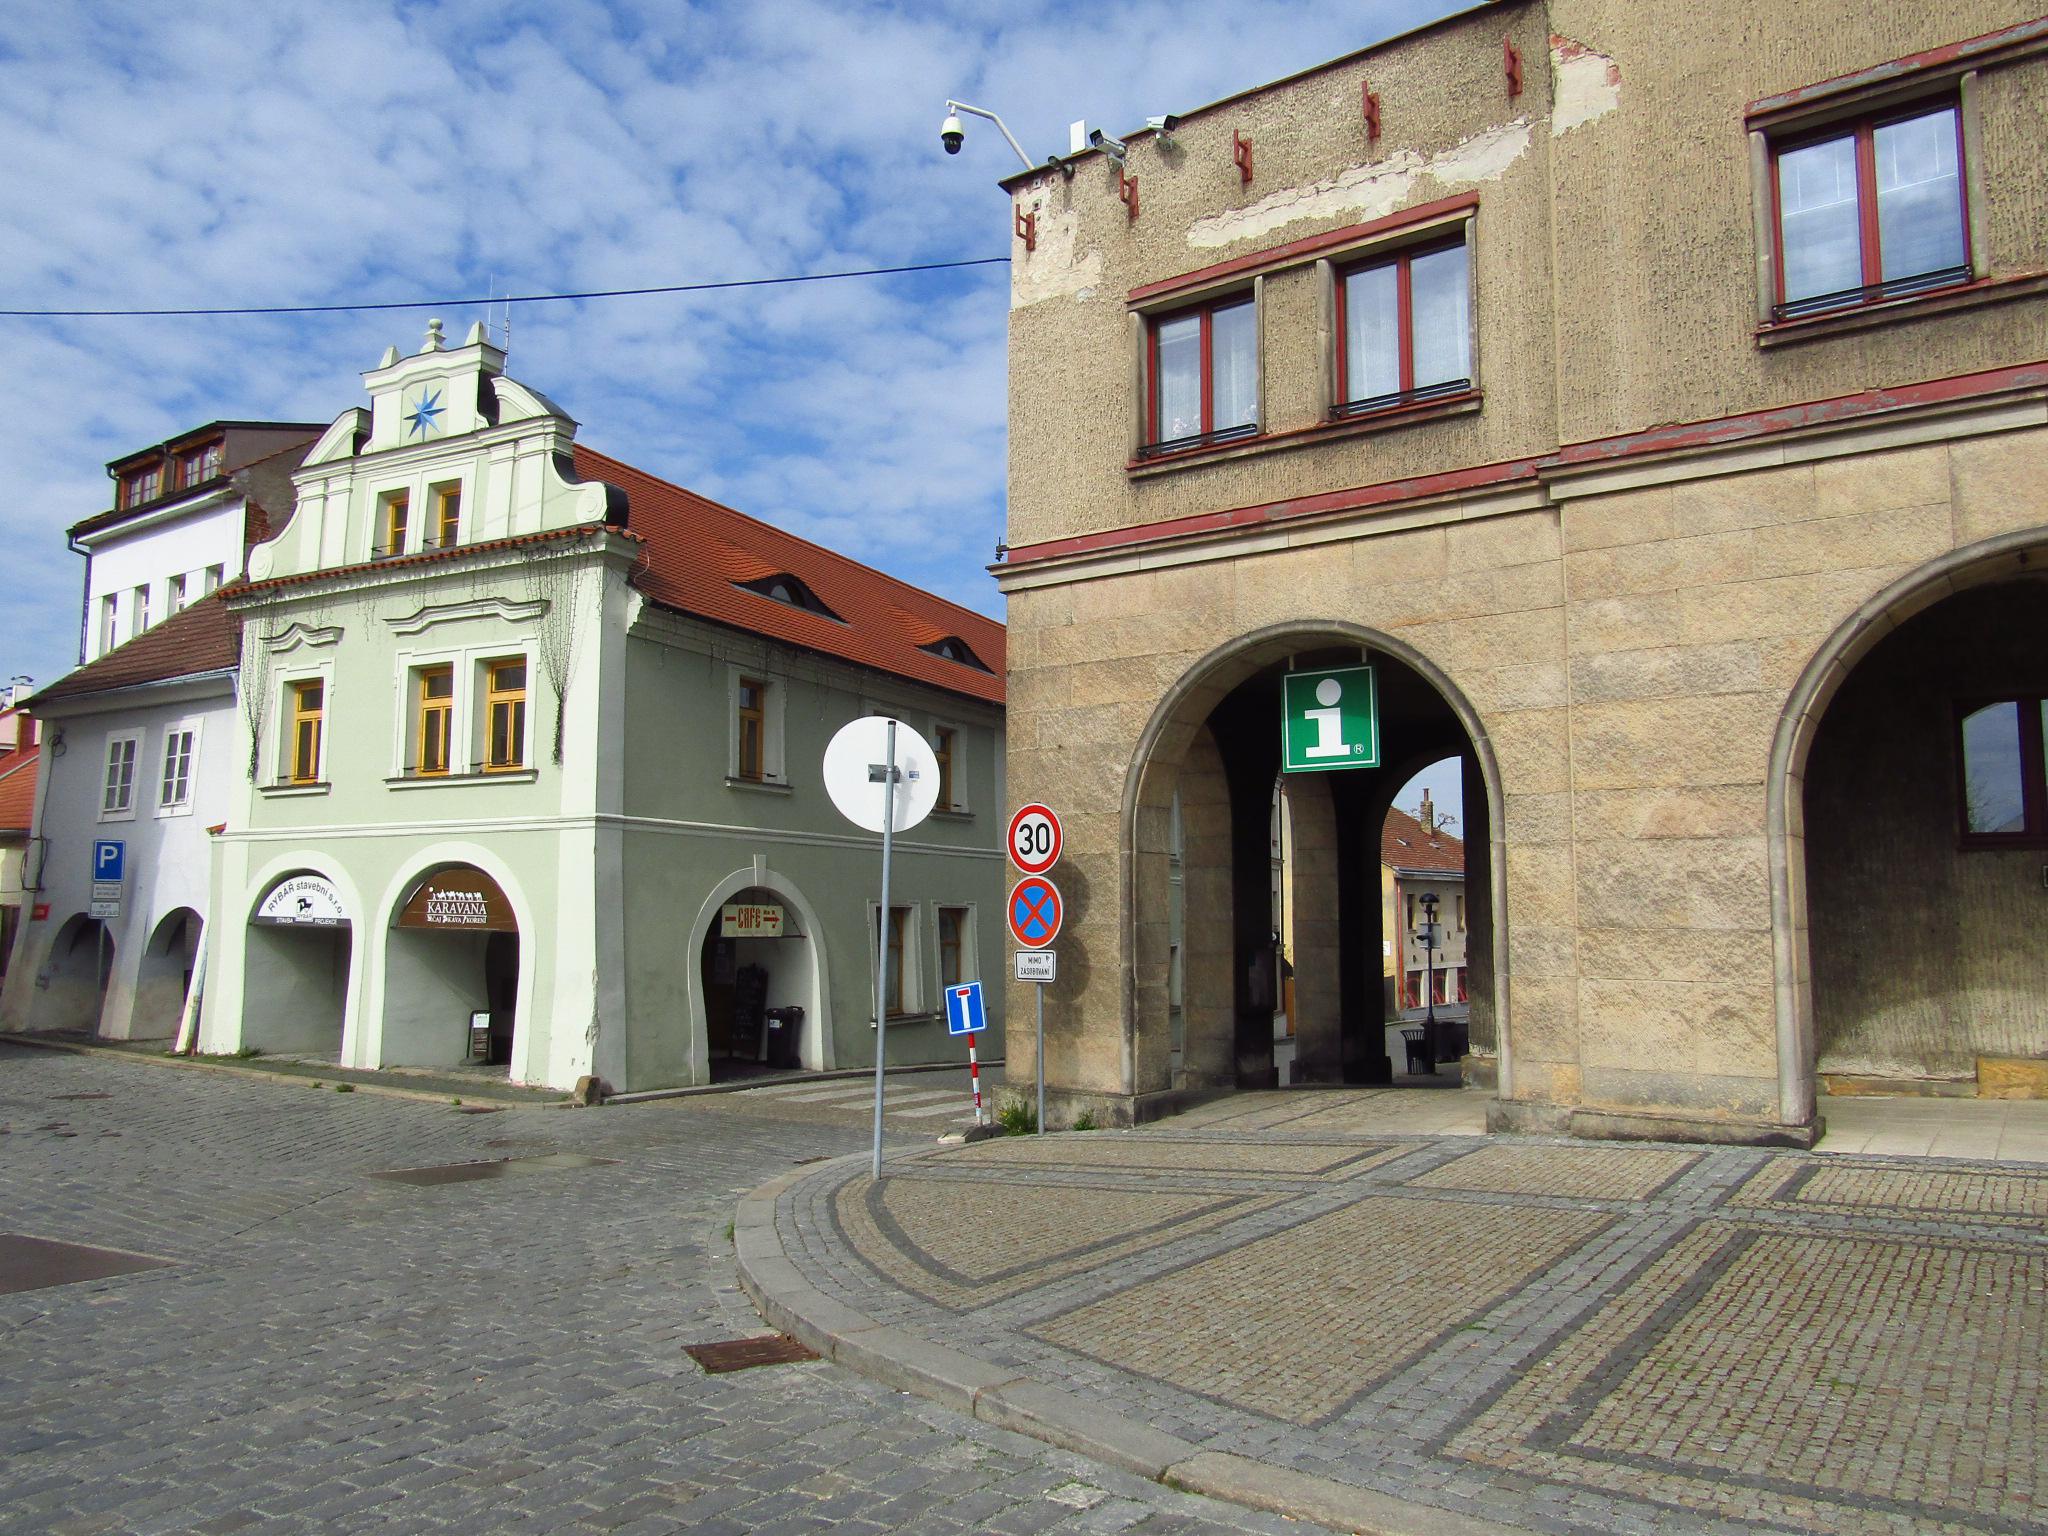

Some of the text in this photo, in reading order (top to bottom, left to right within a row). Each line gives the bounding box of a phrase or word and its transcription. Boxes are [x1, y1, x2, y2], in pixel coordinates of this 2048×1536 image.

[1019, 823, 1050, 855] 30
[100, 845, 118, 868] P
[268, 882, 295, 912] RYBÁŘ
[296, 881, 329, 896] stavební
[428, 902, 487, 914] KARAVANA
[1027, 956, 1042, 965] MIMO
